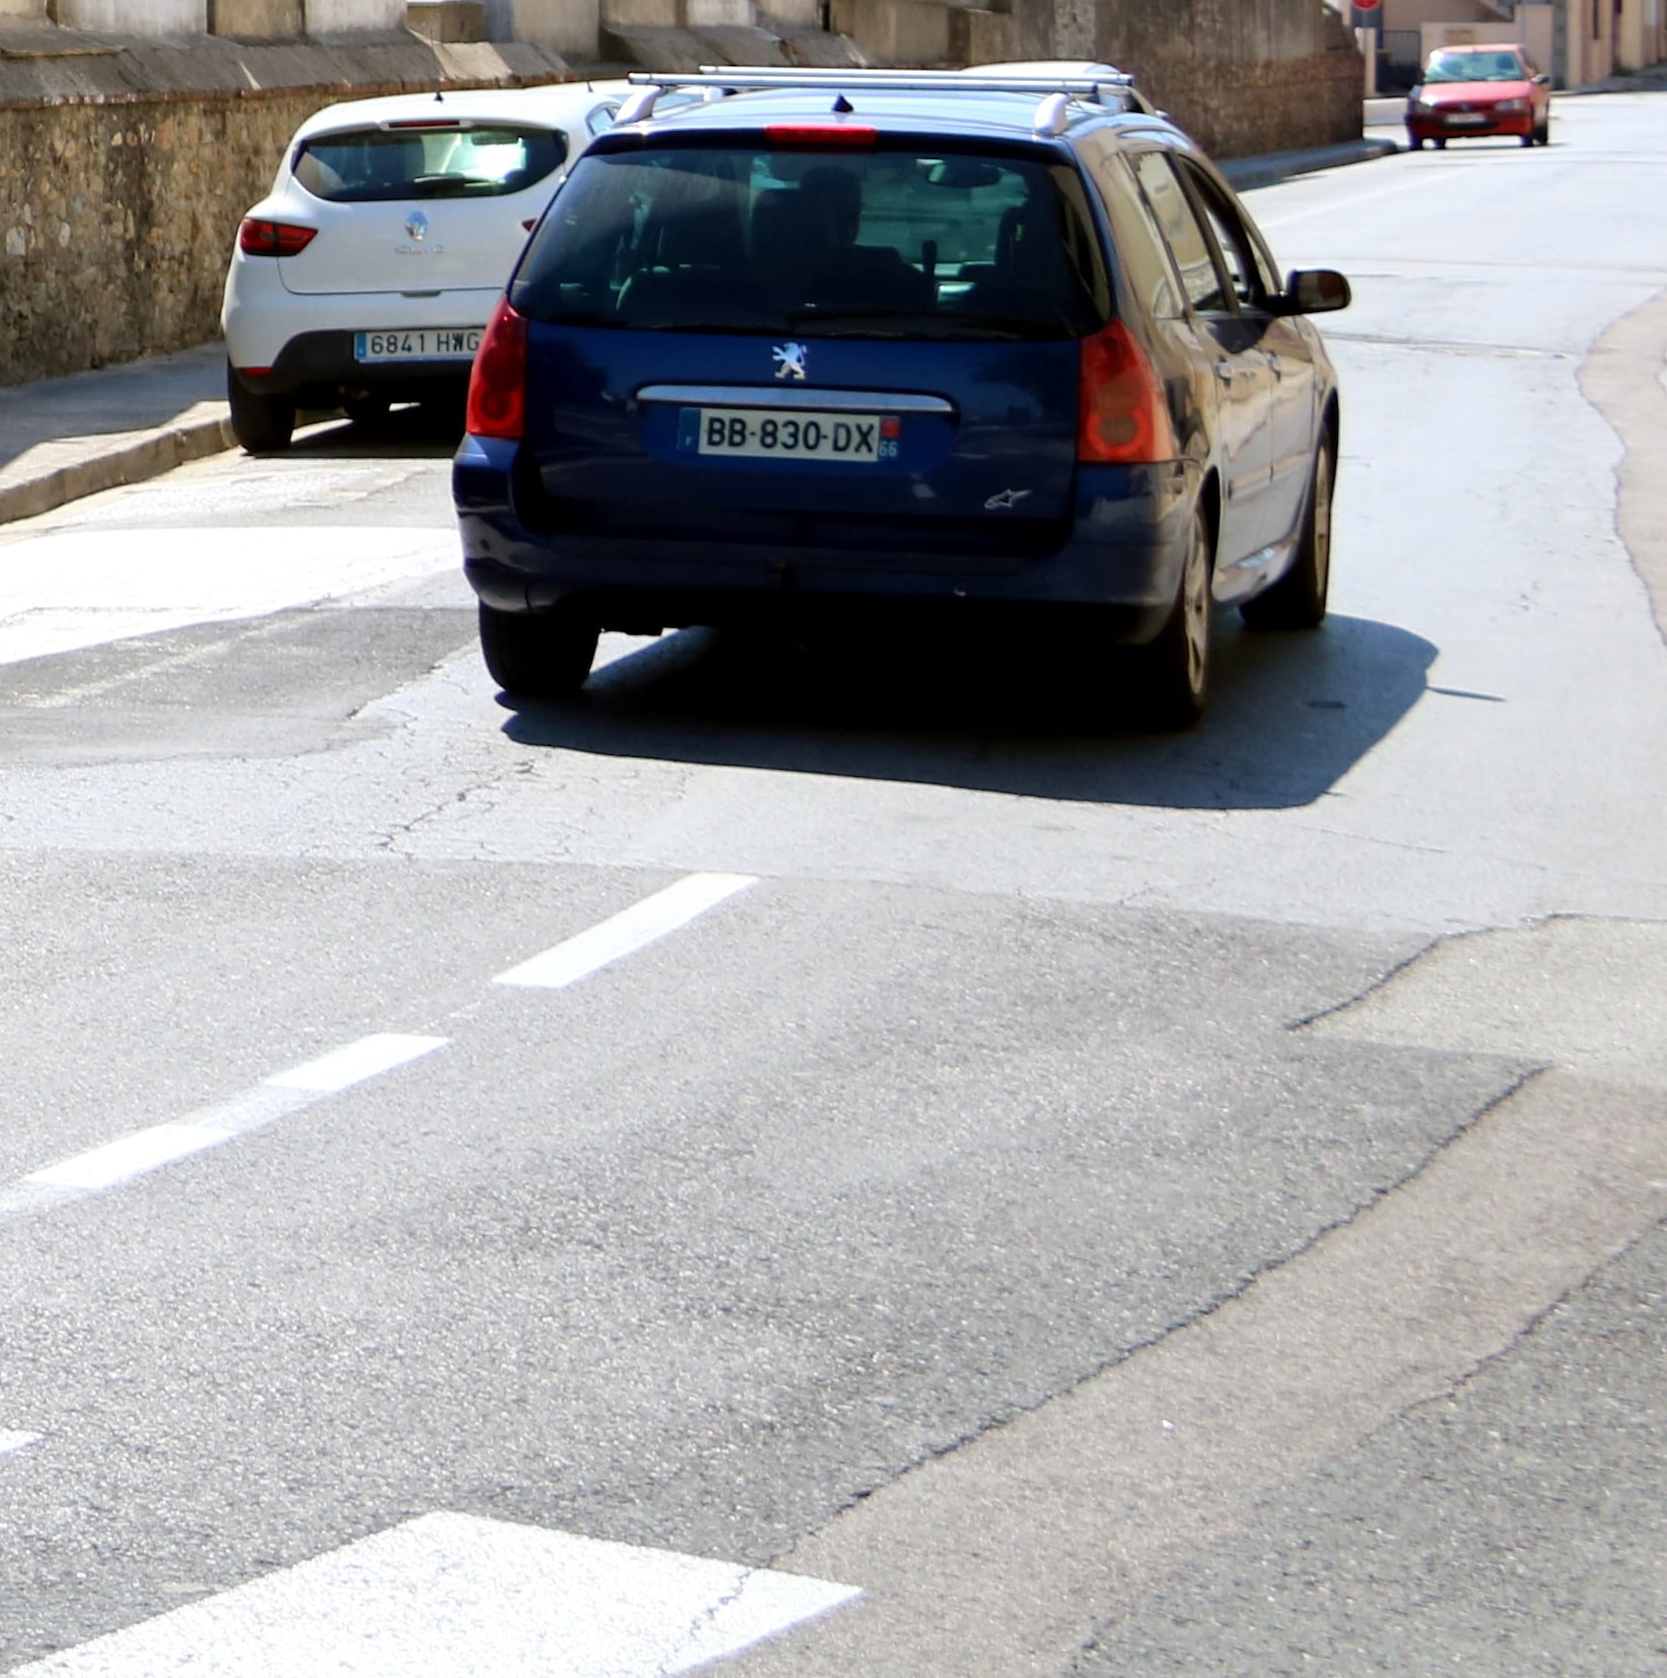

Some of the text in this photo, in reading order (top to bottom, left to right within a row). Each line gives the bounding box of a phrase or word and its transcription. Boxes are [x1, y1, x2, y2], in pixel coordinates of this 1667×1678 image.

[370, 333, 425, 354] 6841
[706, 416, 875, 454] BB-830-DX
[878, 440, 898, 458] 66
